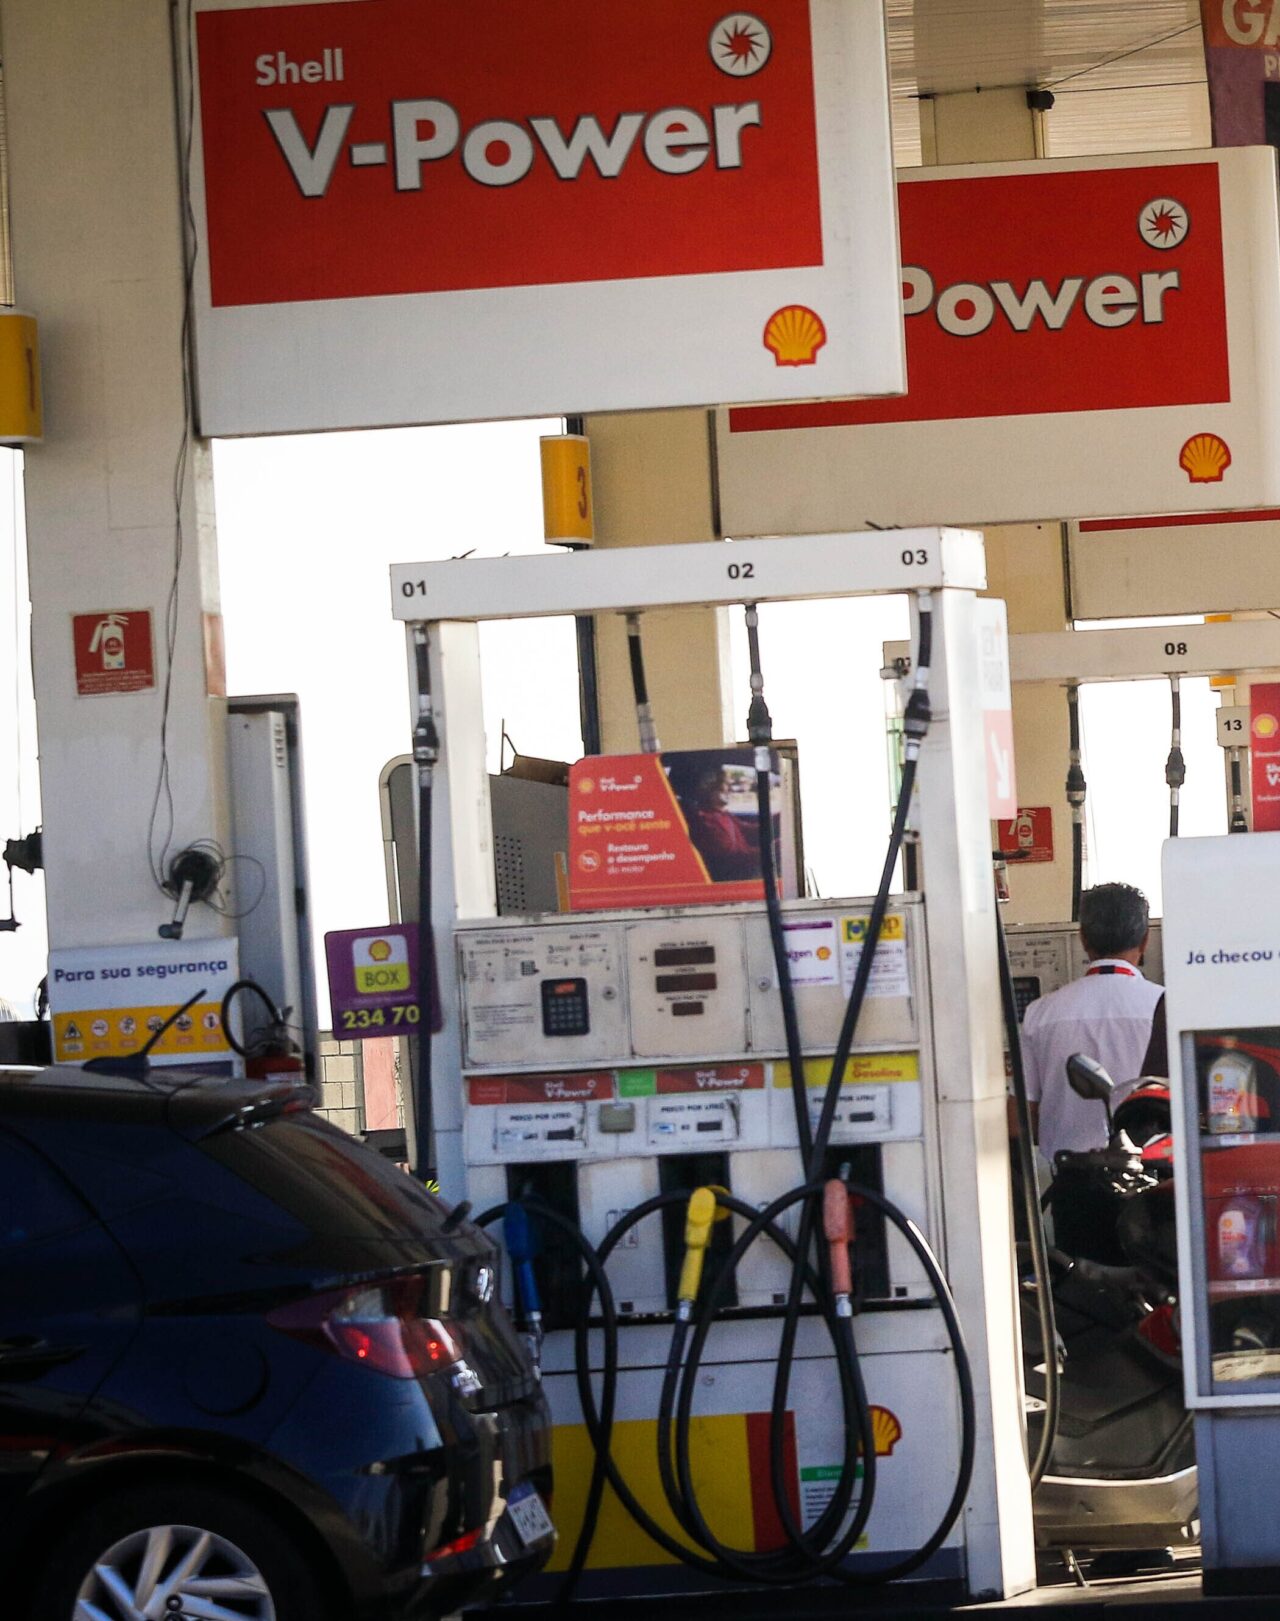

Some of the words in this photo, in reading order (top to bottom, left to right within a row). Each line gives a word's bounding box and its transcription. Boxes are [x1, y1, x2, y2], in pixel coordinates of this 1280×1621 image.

[255, 49, 344, 86] Shell
[262, 98, 762, 198] V-Power
[901, 549, 929, 566] 03
[727, 562, 755, 580] 02
[401, 580, 427, 598] 01
[1165, 642, 1188, 656] 08
[1224, 719, 1242, 731] 13
[578, 808, 655, 822] Performance
[1211, 950, 1273, 964] checou
[54, 967, 95, 983] Para
[101, 966, 131, 980] sua
[137, 958, 228, 980] segurança
[365, 970, 400, 986] BOX
[342, 1008, 385, 1029] 234
[392, 1004, 421, 1025] 70
